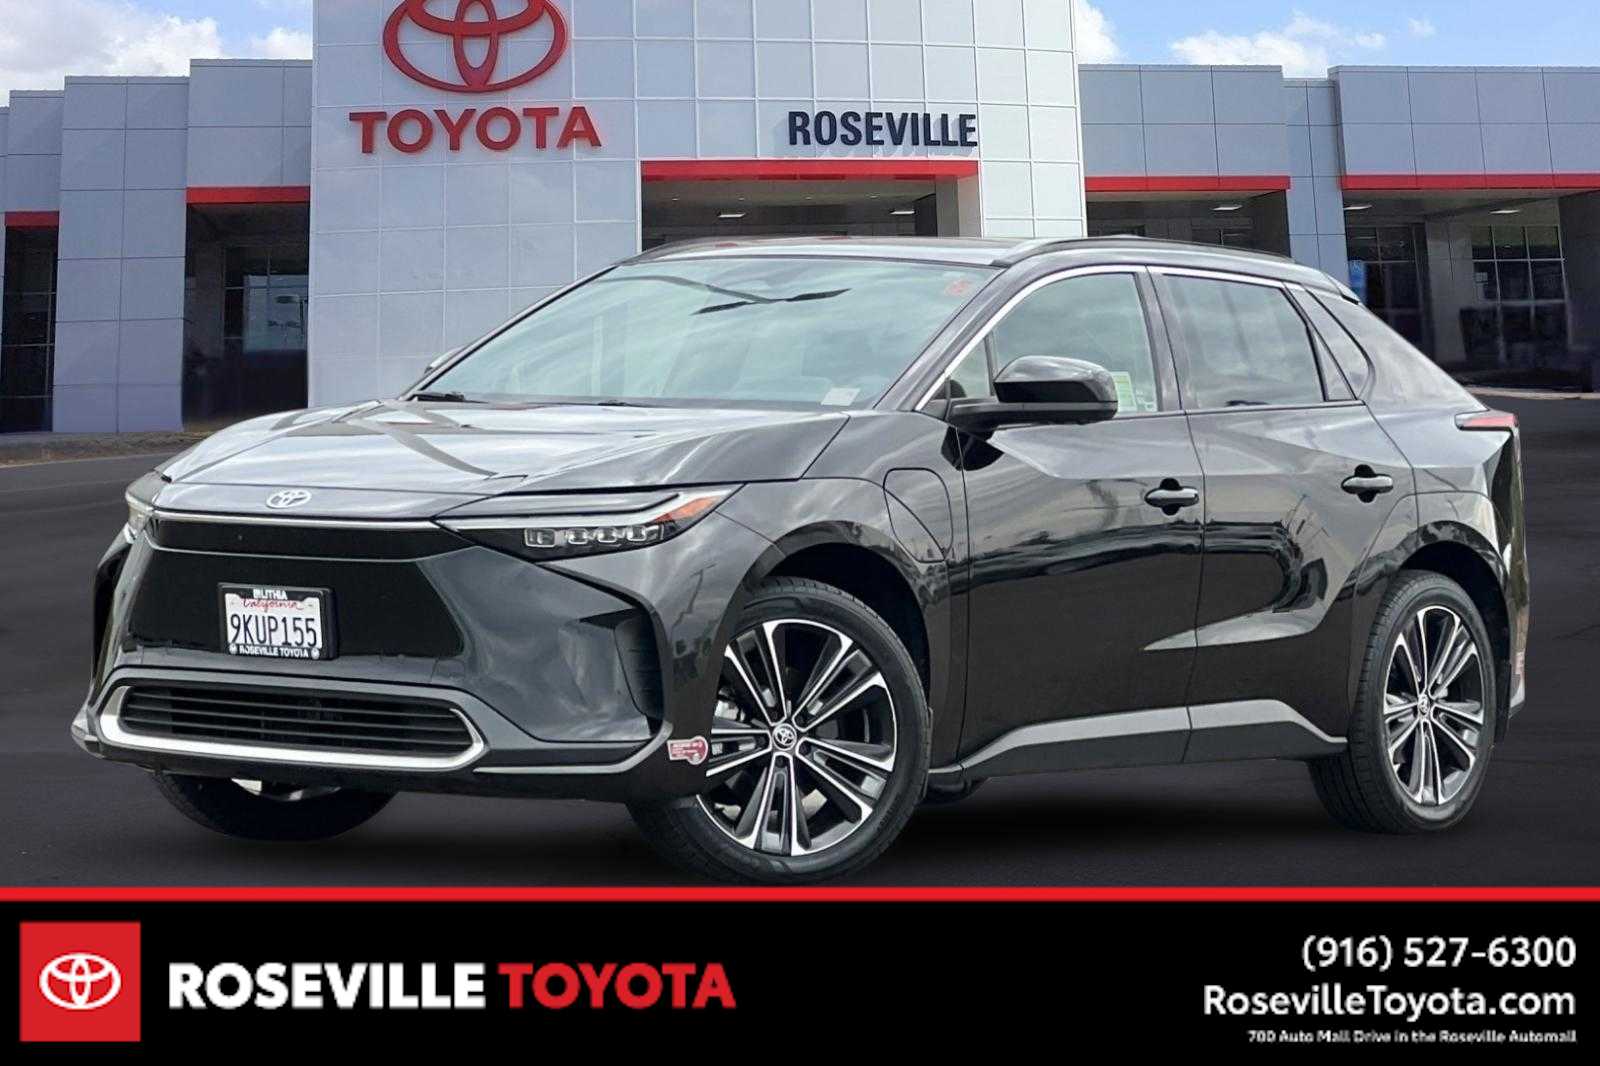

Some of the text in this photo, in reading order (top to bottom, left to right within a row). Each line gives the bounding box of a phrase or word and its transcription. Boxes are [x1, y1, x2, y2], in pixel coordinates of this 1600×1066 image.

[349, 105, 602, 154] TOYOTA
[788, 110, 979, 148] ROSEVILLE
[230, 613, 317, 647] 9KUP155
[239, 645, 309, 658] ROSEVILLE TOYOTA
